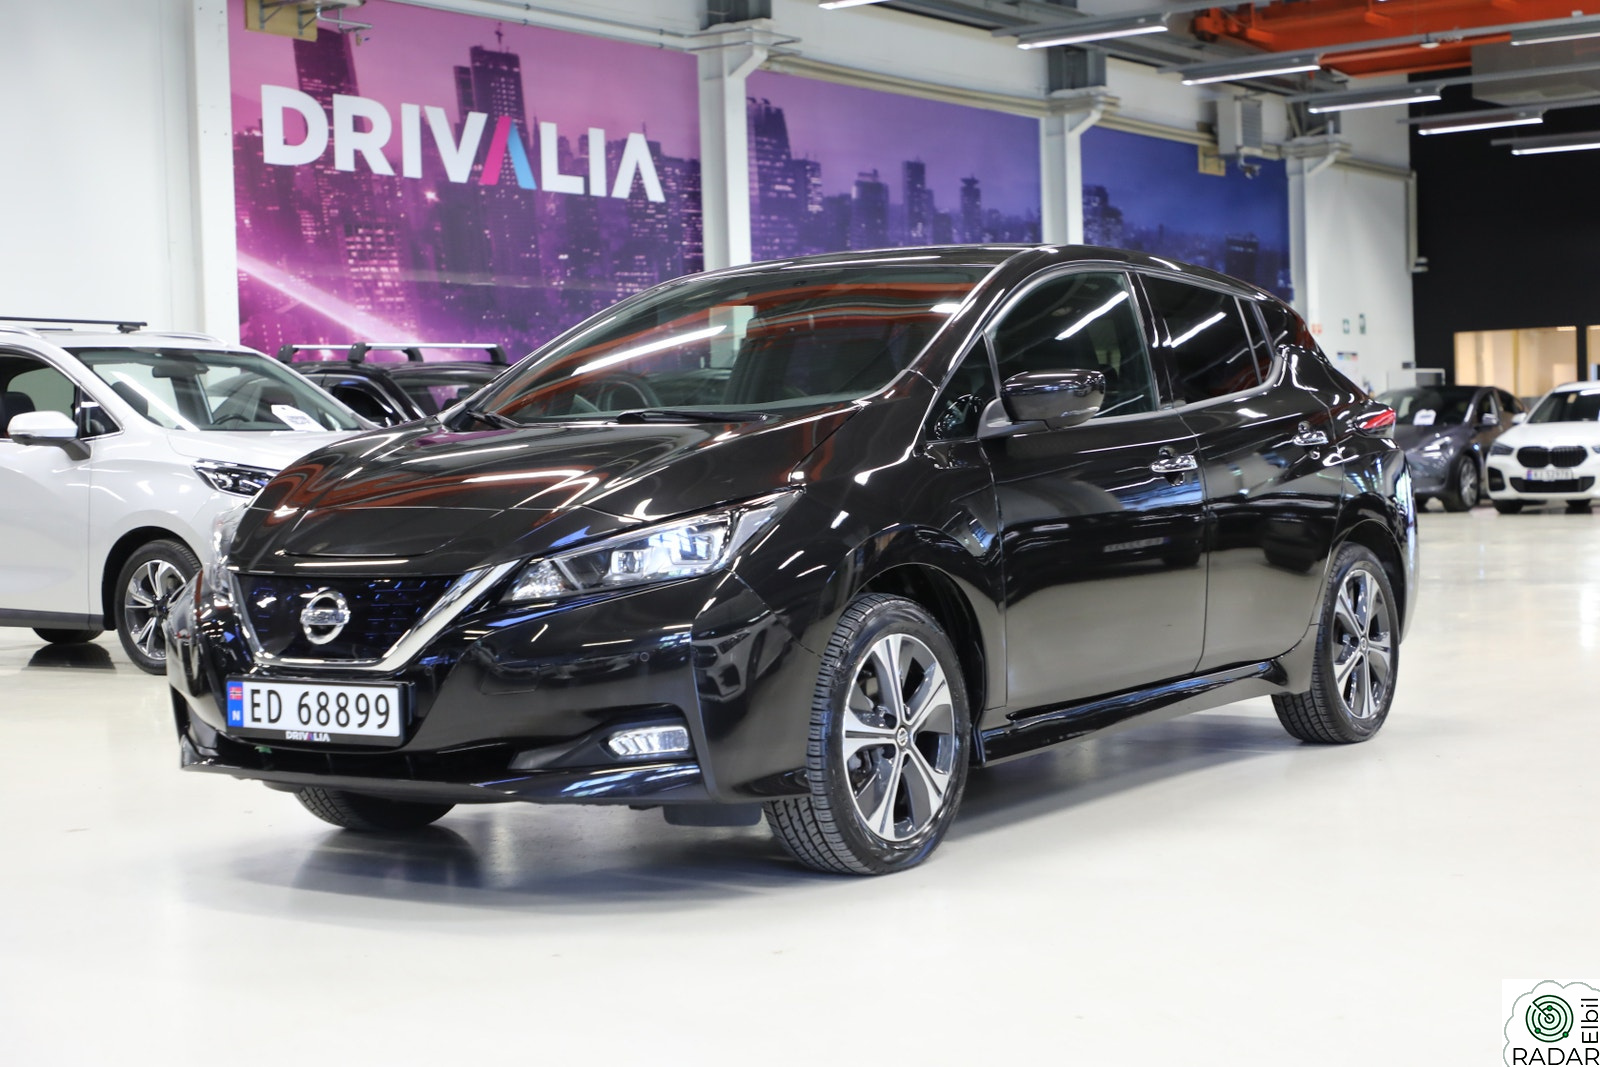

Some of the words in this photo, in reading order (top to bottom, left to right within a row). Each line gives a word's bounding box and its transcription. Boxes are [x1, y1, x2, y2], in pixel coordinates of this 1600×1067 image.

[261, 84, 666, 203] DRIVALIA
[232, 710, 241, 721] N
[250, 688, 282, 724] ED
[298, 691, 390, 729] 68899
[285, 731, 331, 743] DRIVALIA
